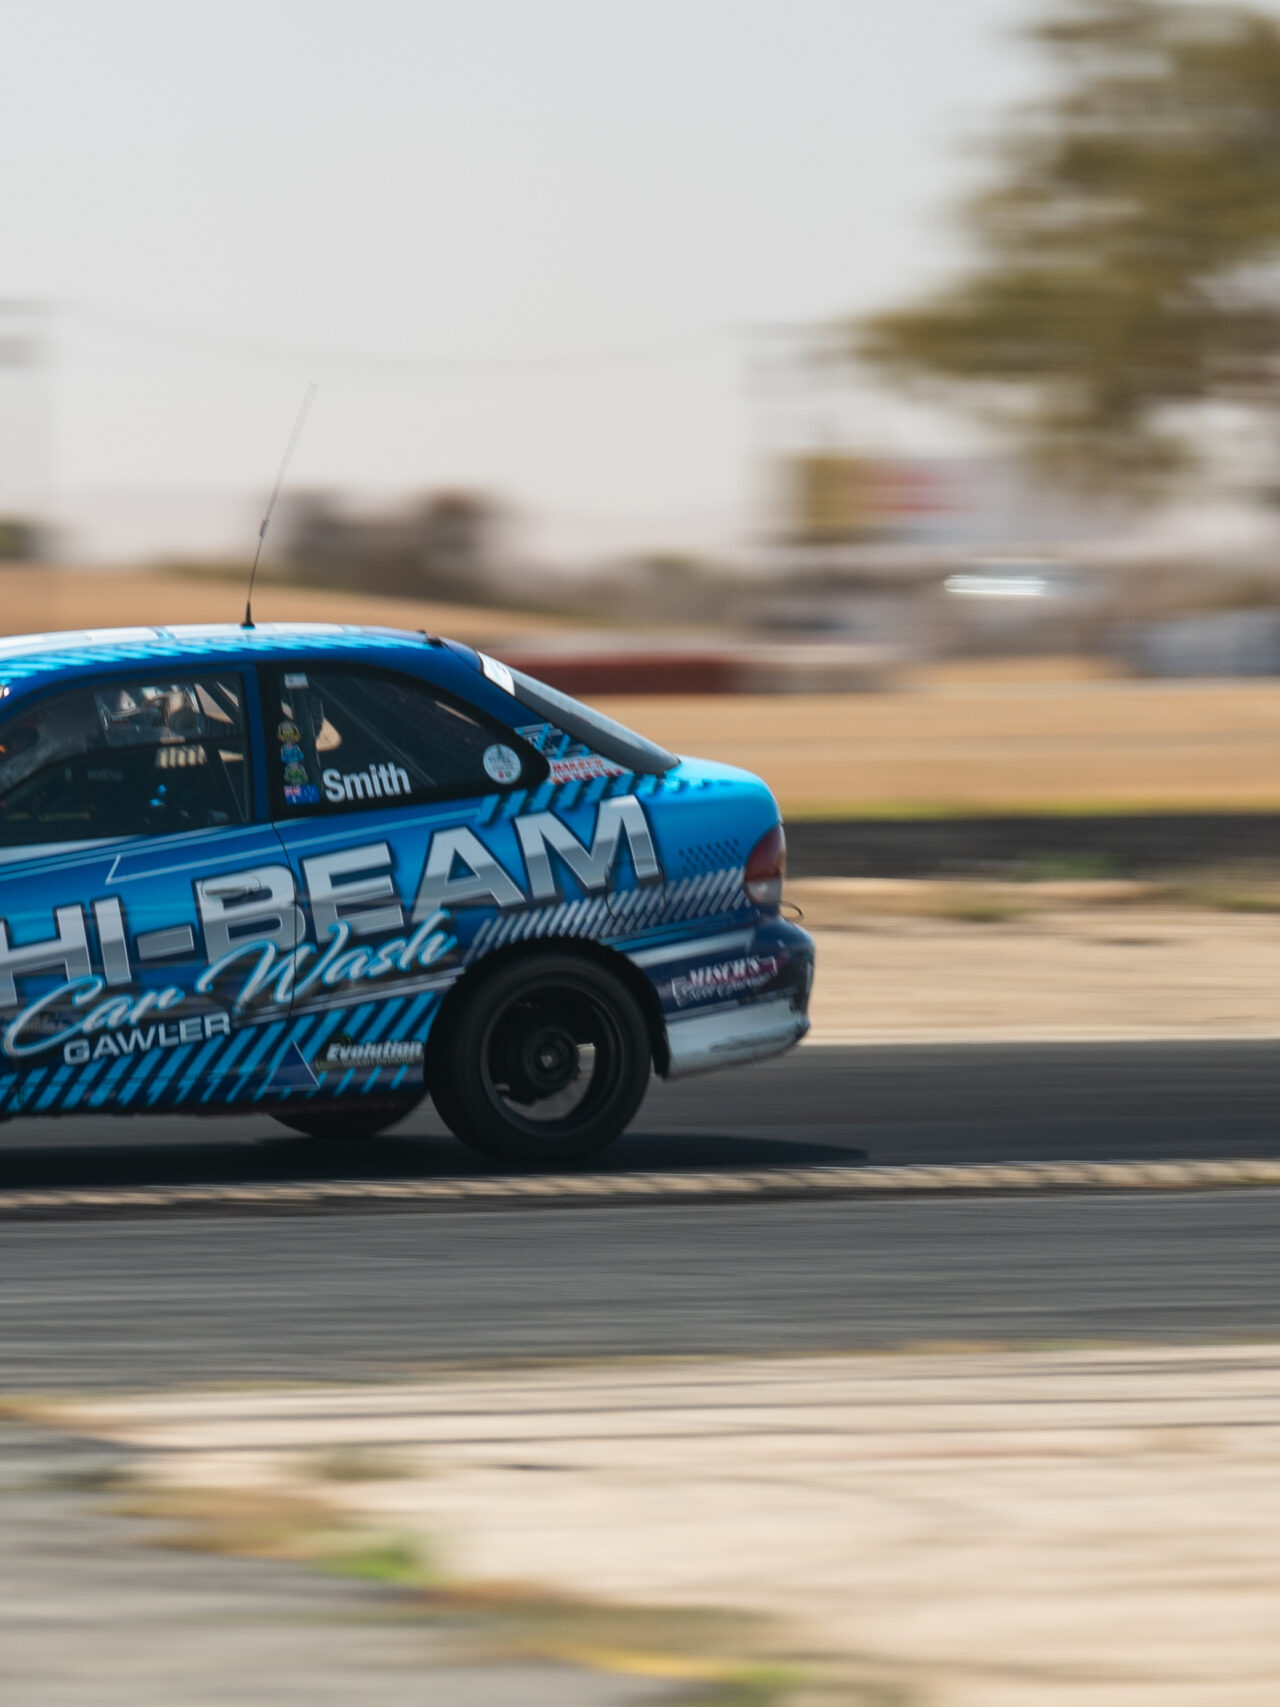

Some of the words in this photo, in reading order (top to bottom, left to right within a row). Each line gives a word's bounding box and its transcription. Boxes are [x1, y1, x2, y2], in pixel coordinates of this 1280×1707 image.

[322, 762, 412, 803] Smith
[1, 975, 185, 1058] Car
[196, 908, 458, 1015] Wash
[64, 1012, 231, 1065] GAWLER
[327, 1040, 423, 1061] Evolution
